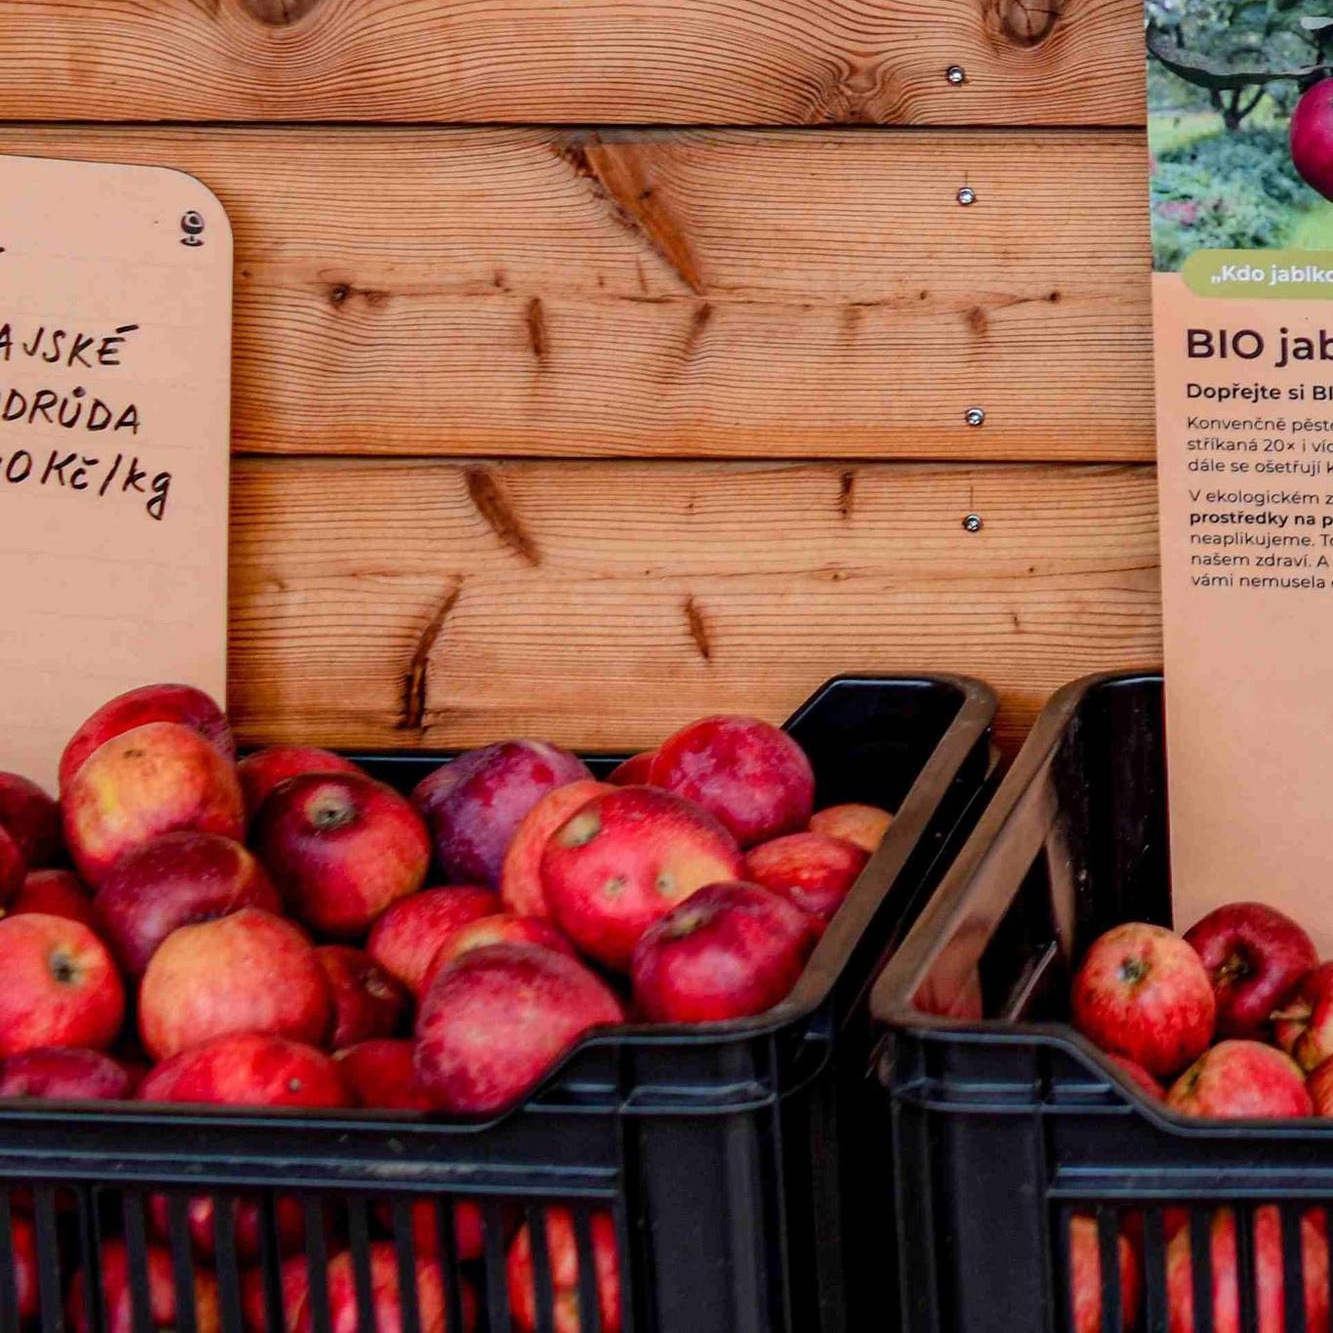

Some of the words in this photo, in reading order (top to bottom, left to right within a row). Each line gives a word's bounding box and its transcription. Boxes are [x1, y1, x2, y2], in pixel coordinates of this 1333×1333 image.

[1210, 264, 1266, 284] „Kdo
[1186, 328, 1265, 360] BIO
[1186, 382, 1282, 404] Dopřejte
[1287, 383, 1305, 401] si
[1187, 416, 1287, 432] Konvenčně
[1187, 437, 1258, 452] stříkaná
[1302, 438, 1307, 453] i
[1187, 457, 1226, 473] dále
[1230, 461, 1250, 473] se
[1254, 459, 1321, 478] ošetřují
[1188, 489, 1202, 503] V
[1205, 488, 1320, 508] ekologickém
[1189, 510, 1290, 529] prostředky
[1294, 514, 1316, 526] na
[1190, 531, 1316, 549] neaplikujeme.
[1190, 552, 1250, 567] našem
[1255, 553, 1312, 568] zdraví.
[1316, 554, 1330, 568] A
[1190, 572, 1234, 587] vámi
[1238, 574, 1326, 589] nemusela
